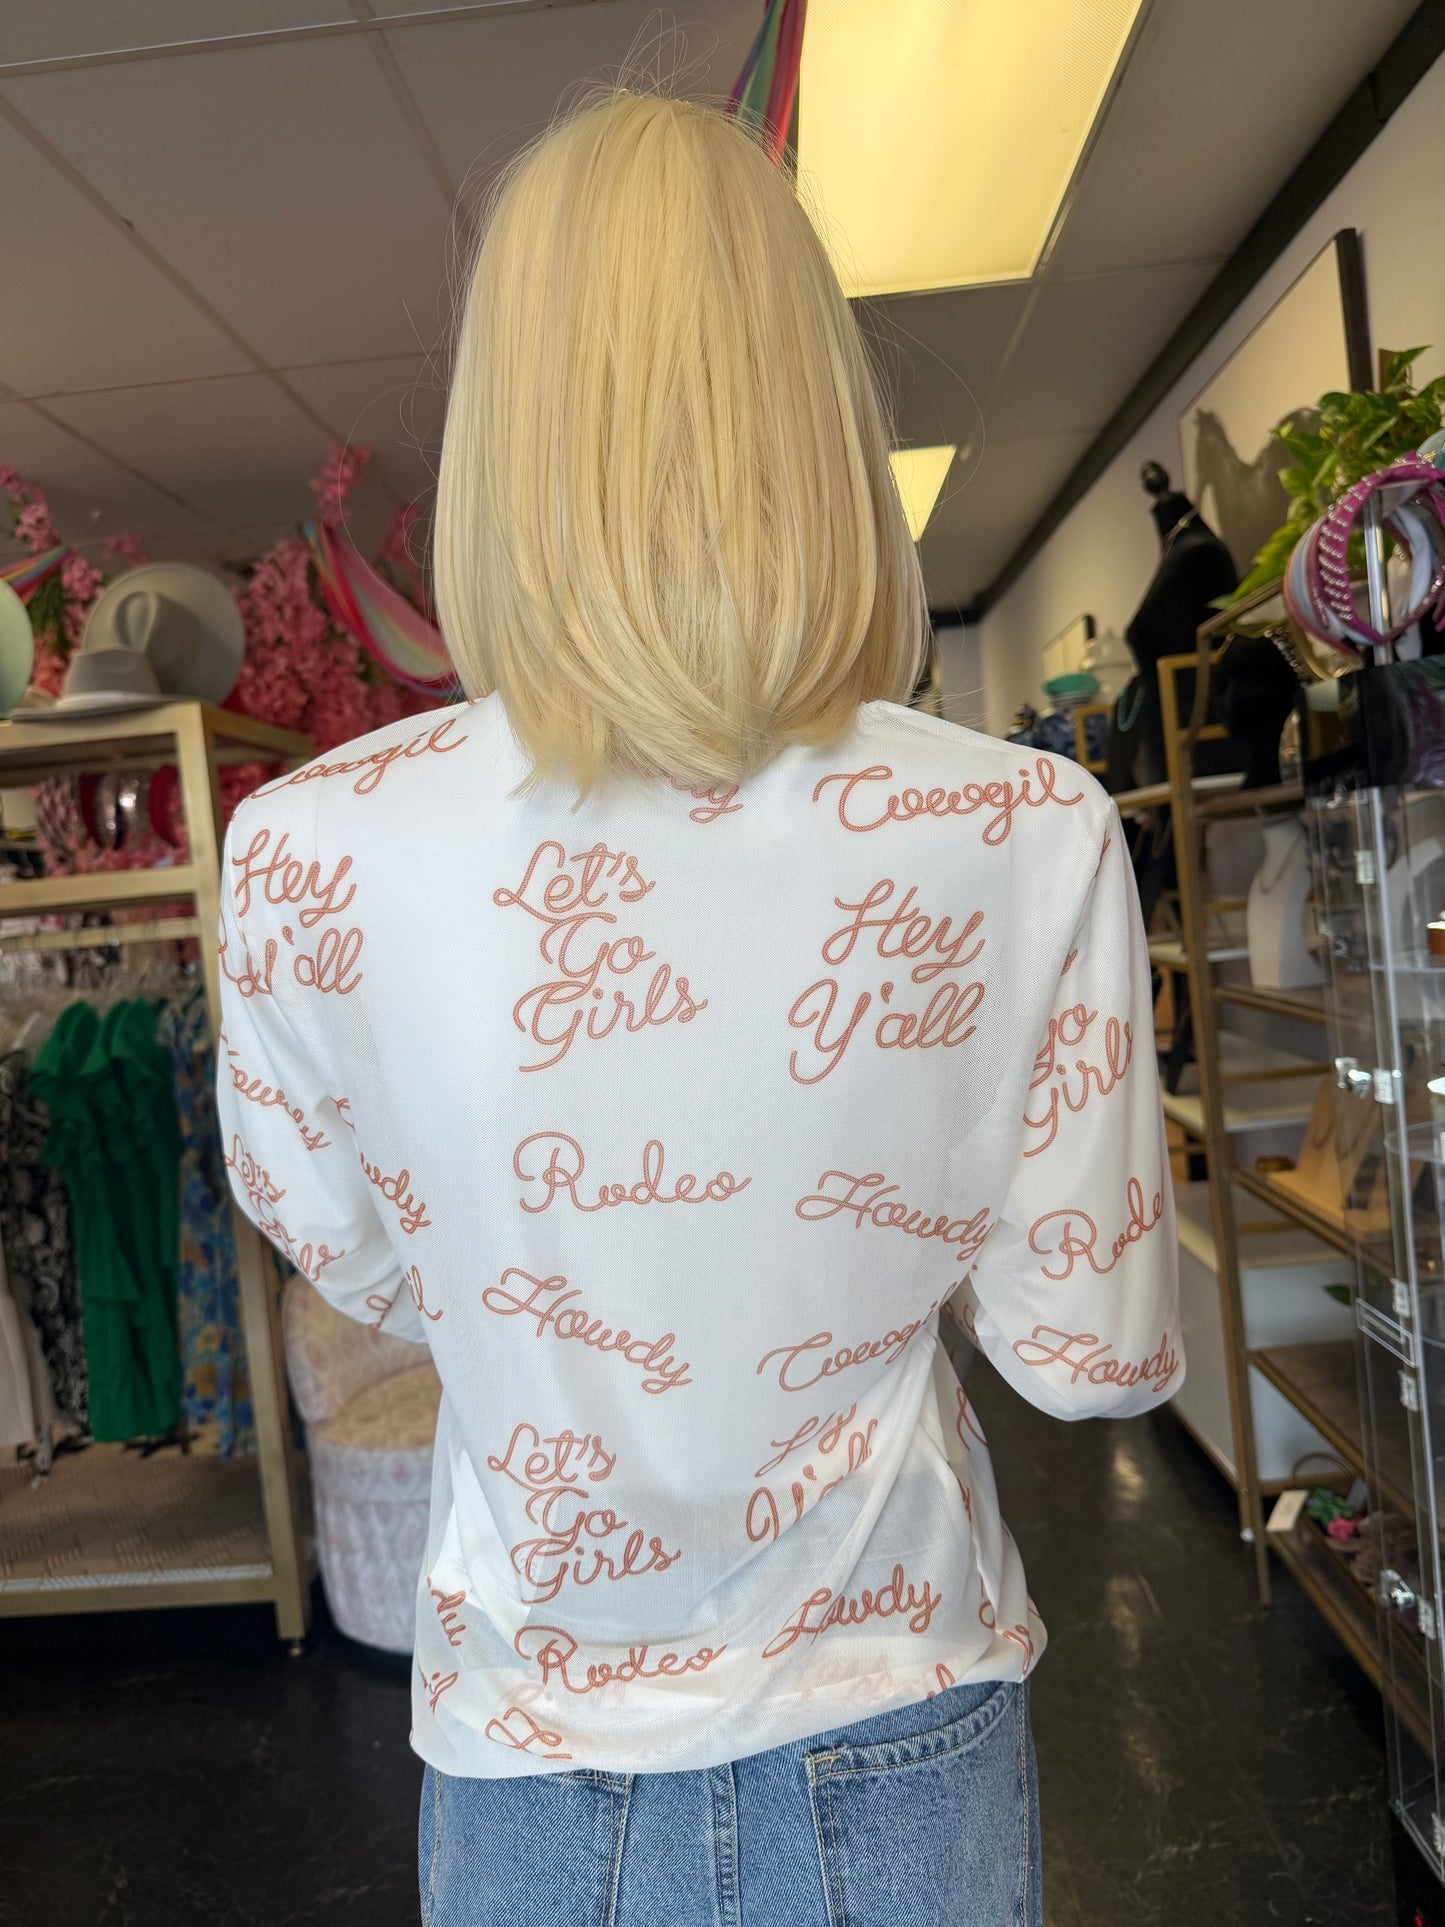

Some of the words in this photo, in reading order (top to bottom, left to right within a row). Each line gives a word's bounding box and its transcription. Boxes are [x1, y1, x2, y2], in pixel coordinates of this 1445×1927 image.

[231, 828, 357, 928] Hey
[492, 840, 656, 924] Let's
[539, 911, 656, 1005] Go
[821, 878, 986, 984] Hey
[512, 963, 709, 1073] Girls
[787, 978, 986, 1086] Y'all
[360, 1152, 432, 1235] wdy
[512, 1130, 753, 1214] Rodeo
[795, 1169, 996, 1262] Howdy
[1027, 1176, 1165, 1281] Rode
[481, 1267, 694, 1395] Howdy
[1011, 1324, 1179, 1393] Howdy
[487, 1422, 617, 1493] Let's
[524, 1486, 629, 1557] Go
[510, 1529, 682, 1605] Girls
[514, 1624, 729, 1694] Rodeo
